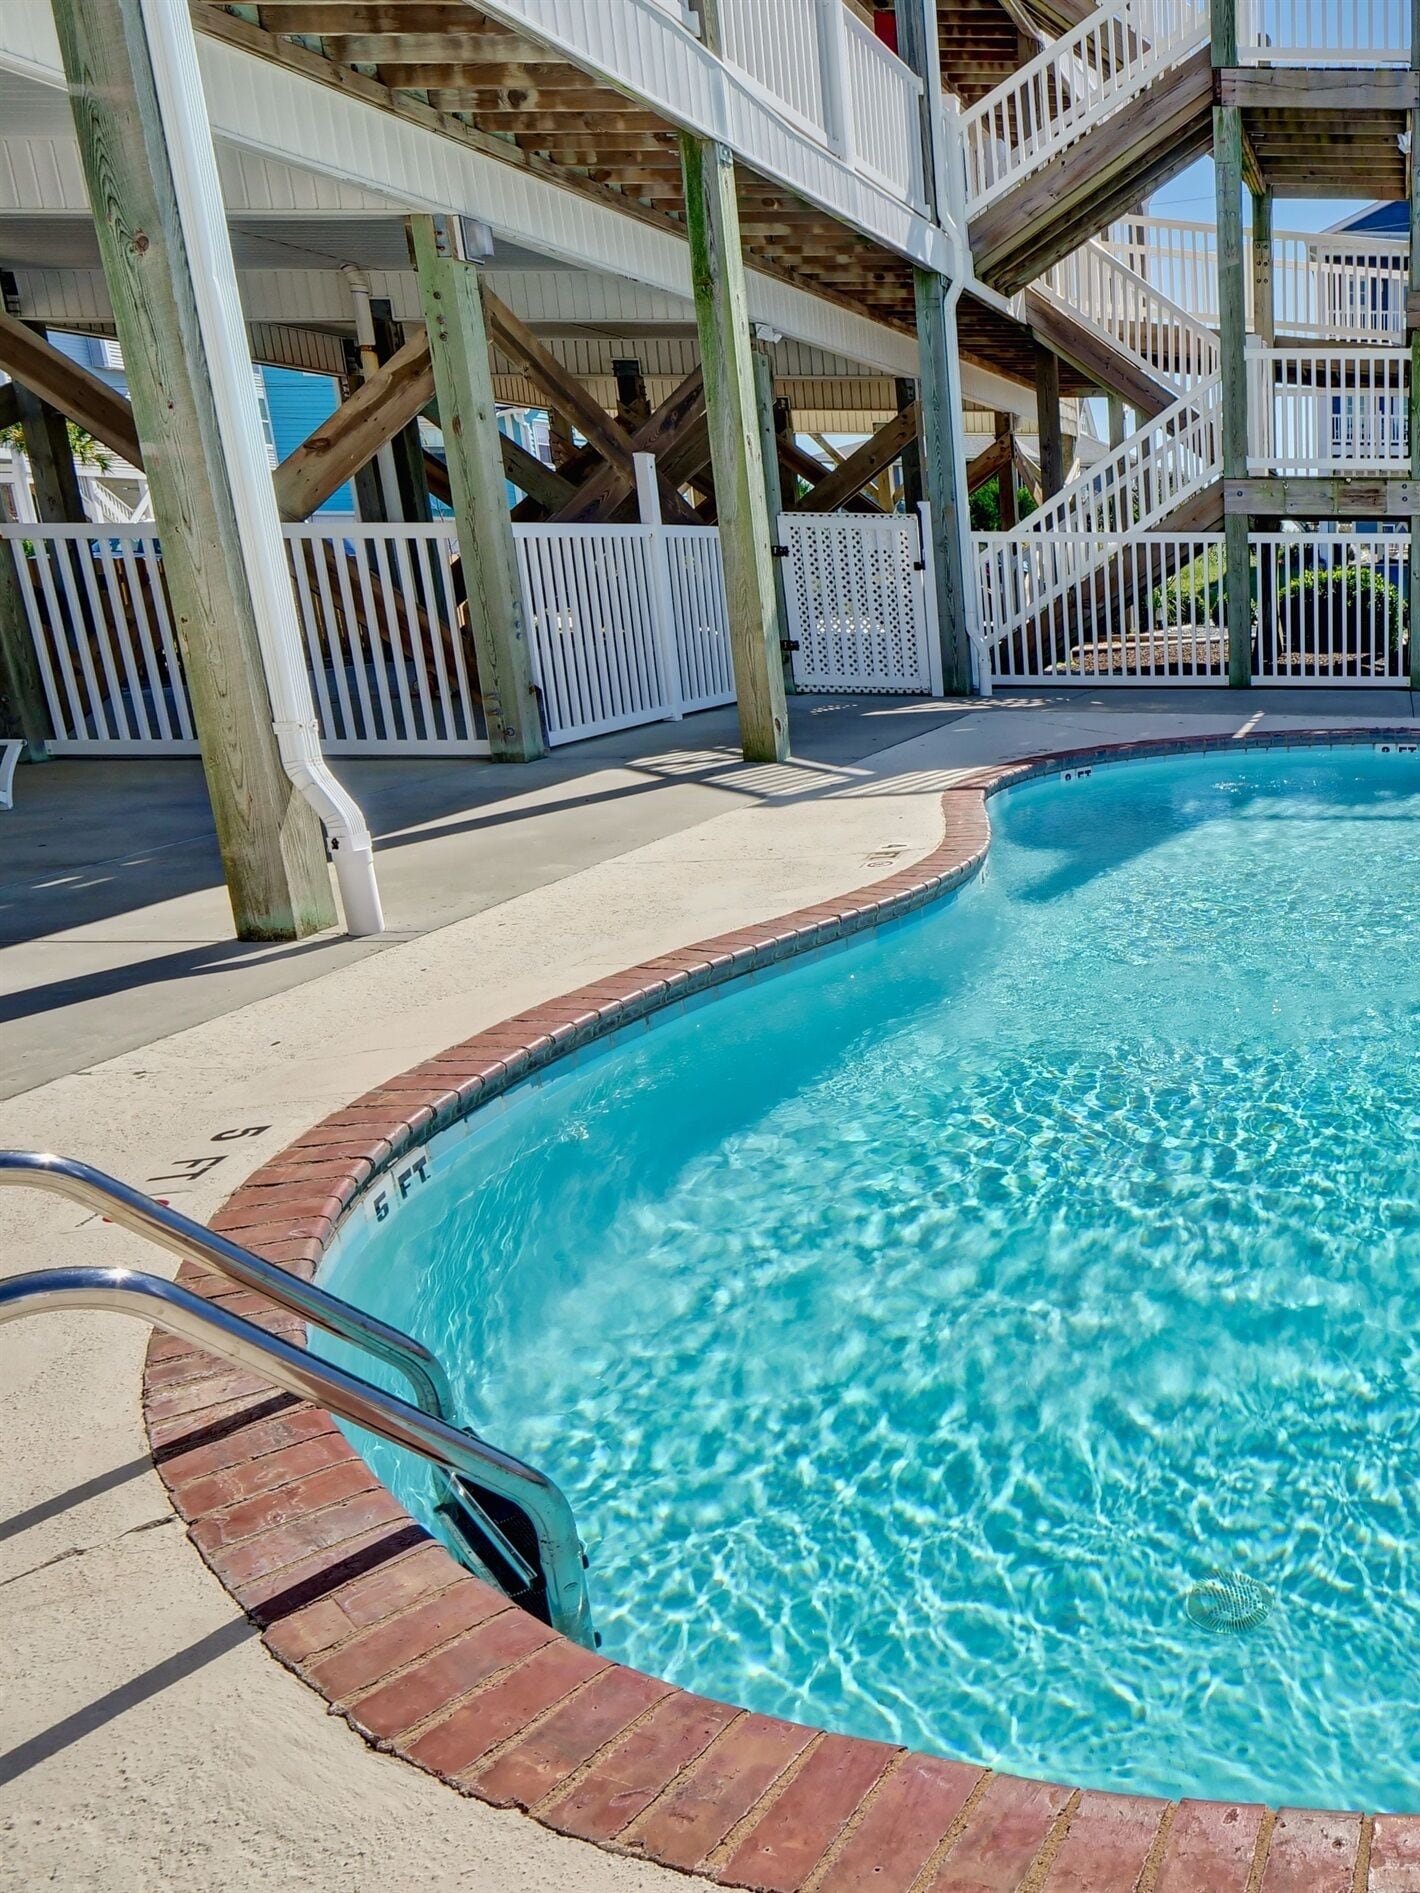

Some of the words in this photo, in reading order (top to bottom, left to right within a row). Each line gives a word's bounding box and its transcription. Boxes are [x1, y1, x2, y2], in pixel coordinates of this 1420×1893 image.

[210, 1125, 272, 1141] 5
[145, 1155, 229, 1182] FT
[373, 1191, 389, 1223] 5
